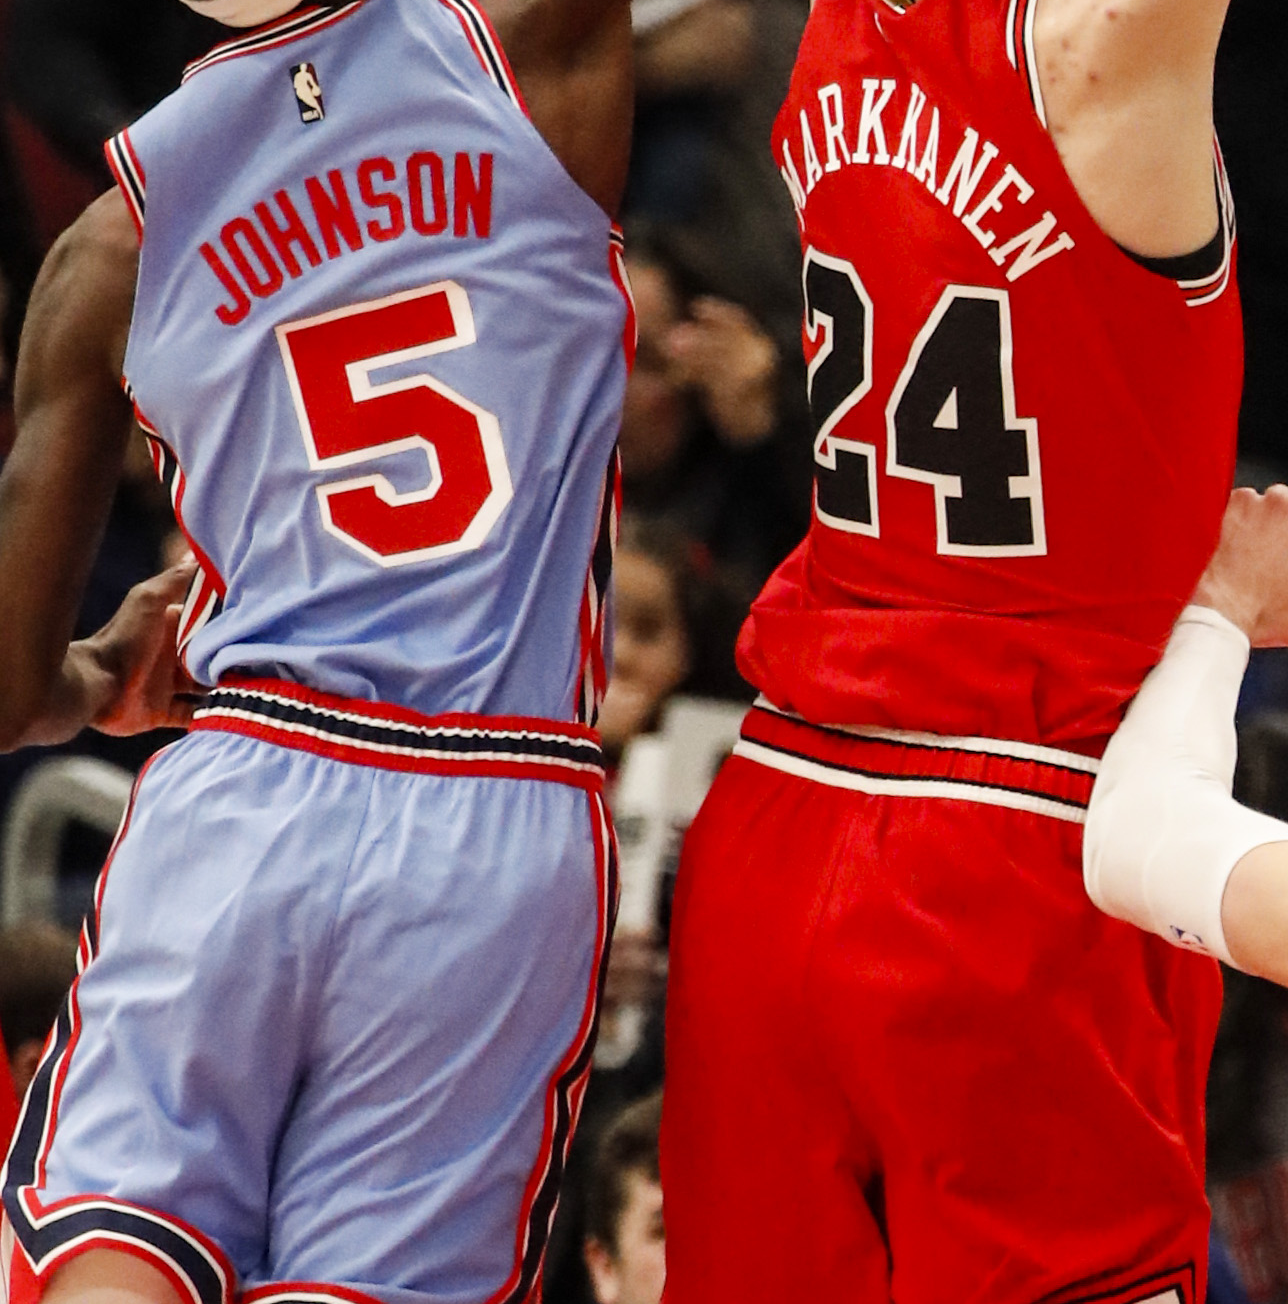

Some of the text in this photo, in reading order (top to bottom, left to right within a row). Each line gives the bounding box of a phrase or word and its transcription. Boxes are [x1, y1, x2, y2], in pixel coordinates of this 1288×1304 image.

[199, 151, 494, 326] JOHNSON
[273, 280, 514, 568] 5
[802, 244, 1047, 557] 24
